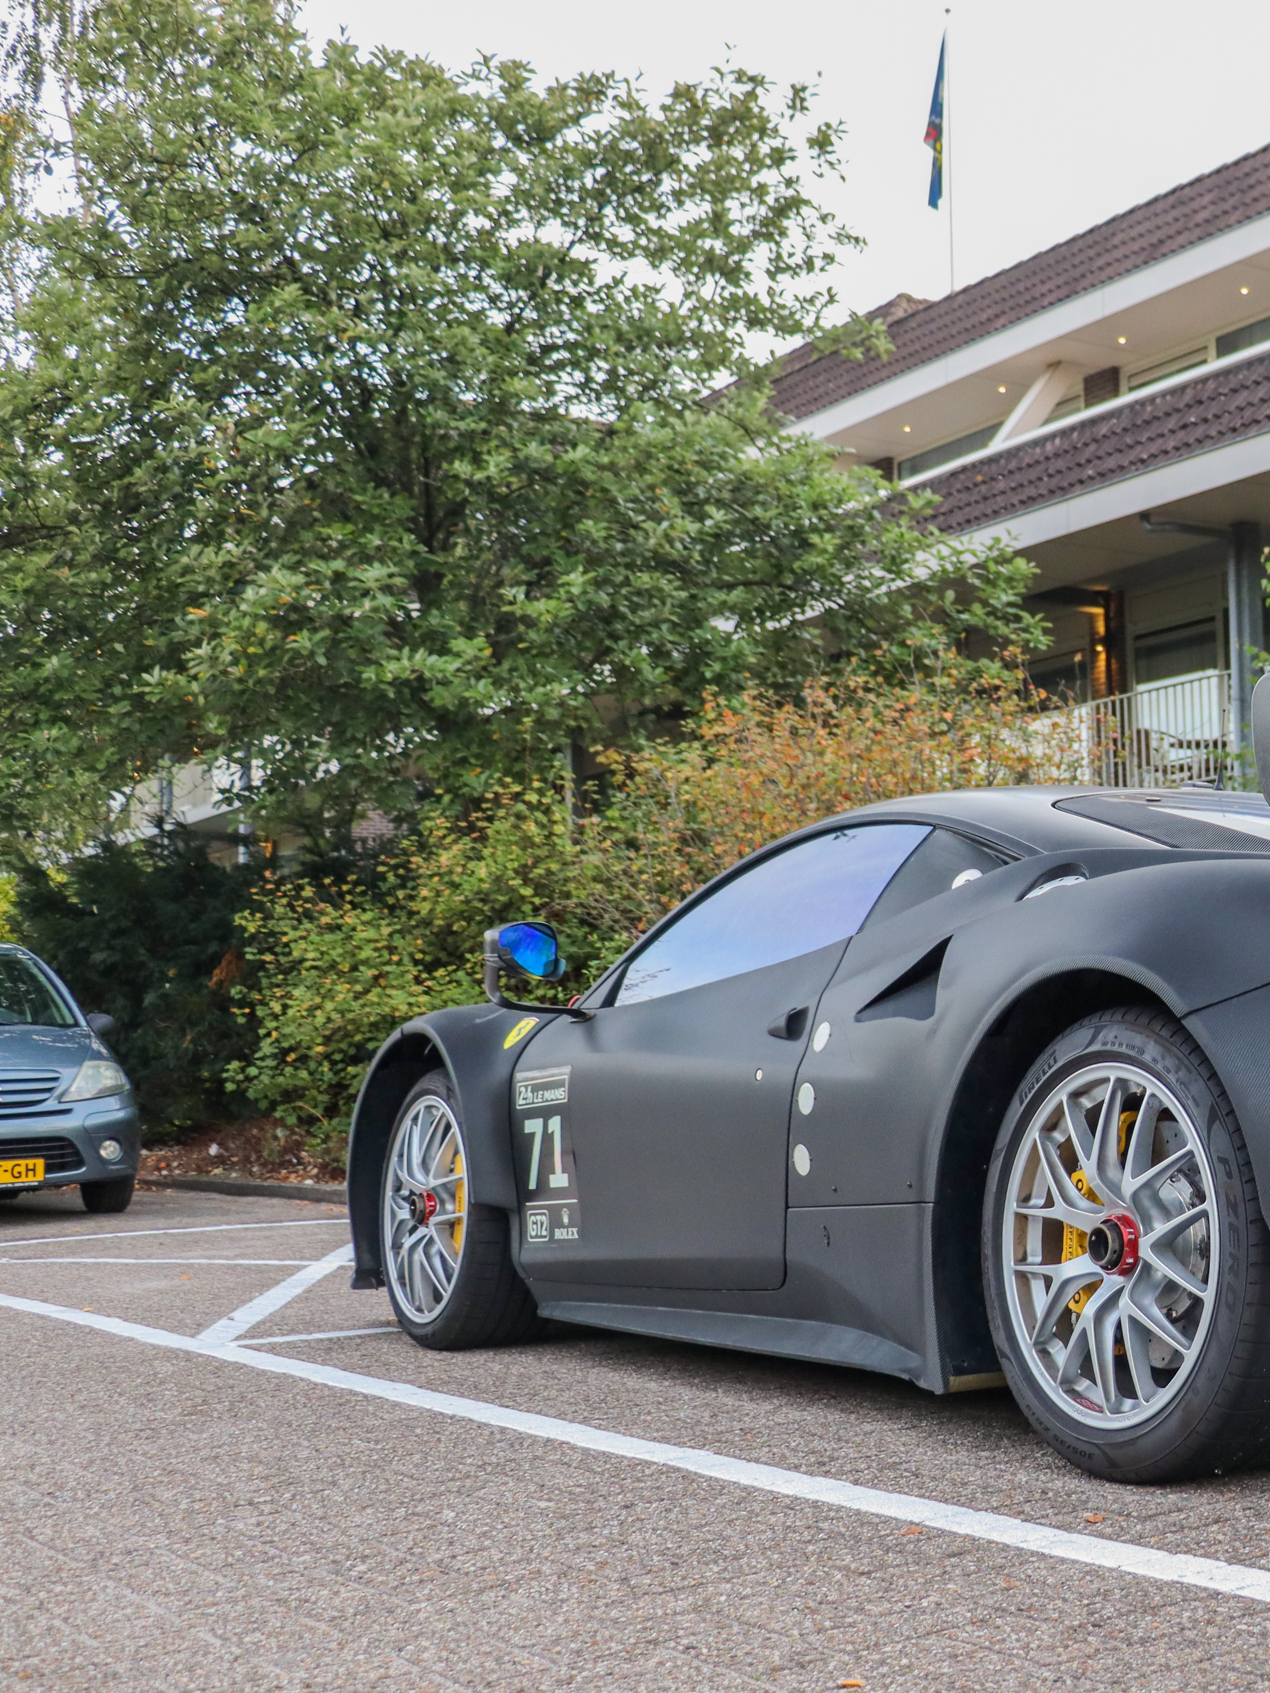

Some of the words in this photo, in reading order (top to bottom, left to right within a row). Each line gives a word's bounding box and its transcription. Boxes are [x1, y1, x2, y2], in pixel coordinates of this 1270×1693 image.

[1019, 1049, 1058, 1107] PIRELLI
[534, 1091, 544, 1103] LE
[543, 1087, 566, 1102] MANS
[524, 1115, 569, 1190] 71
[1217, 1155, 1234, 1181] P
[529, 1214, 548, 1237] GT2
[554, 1227, 579, 1240] ROLEX
[1225, 1190, 1241, 1314] ZERO
